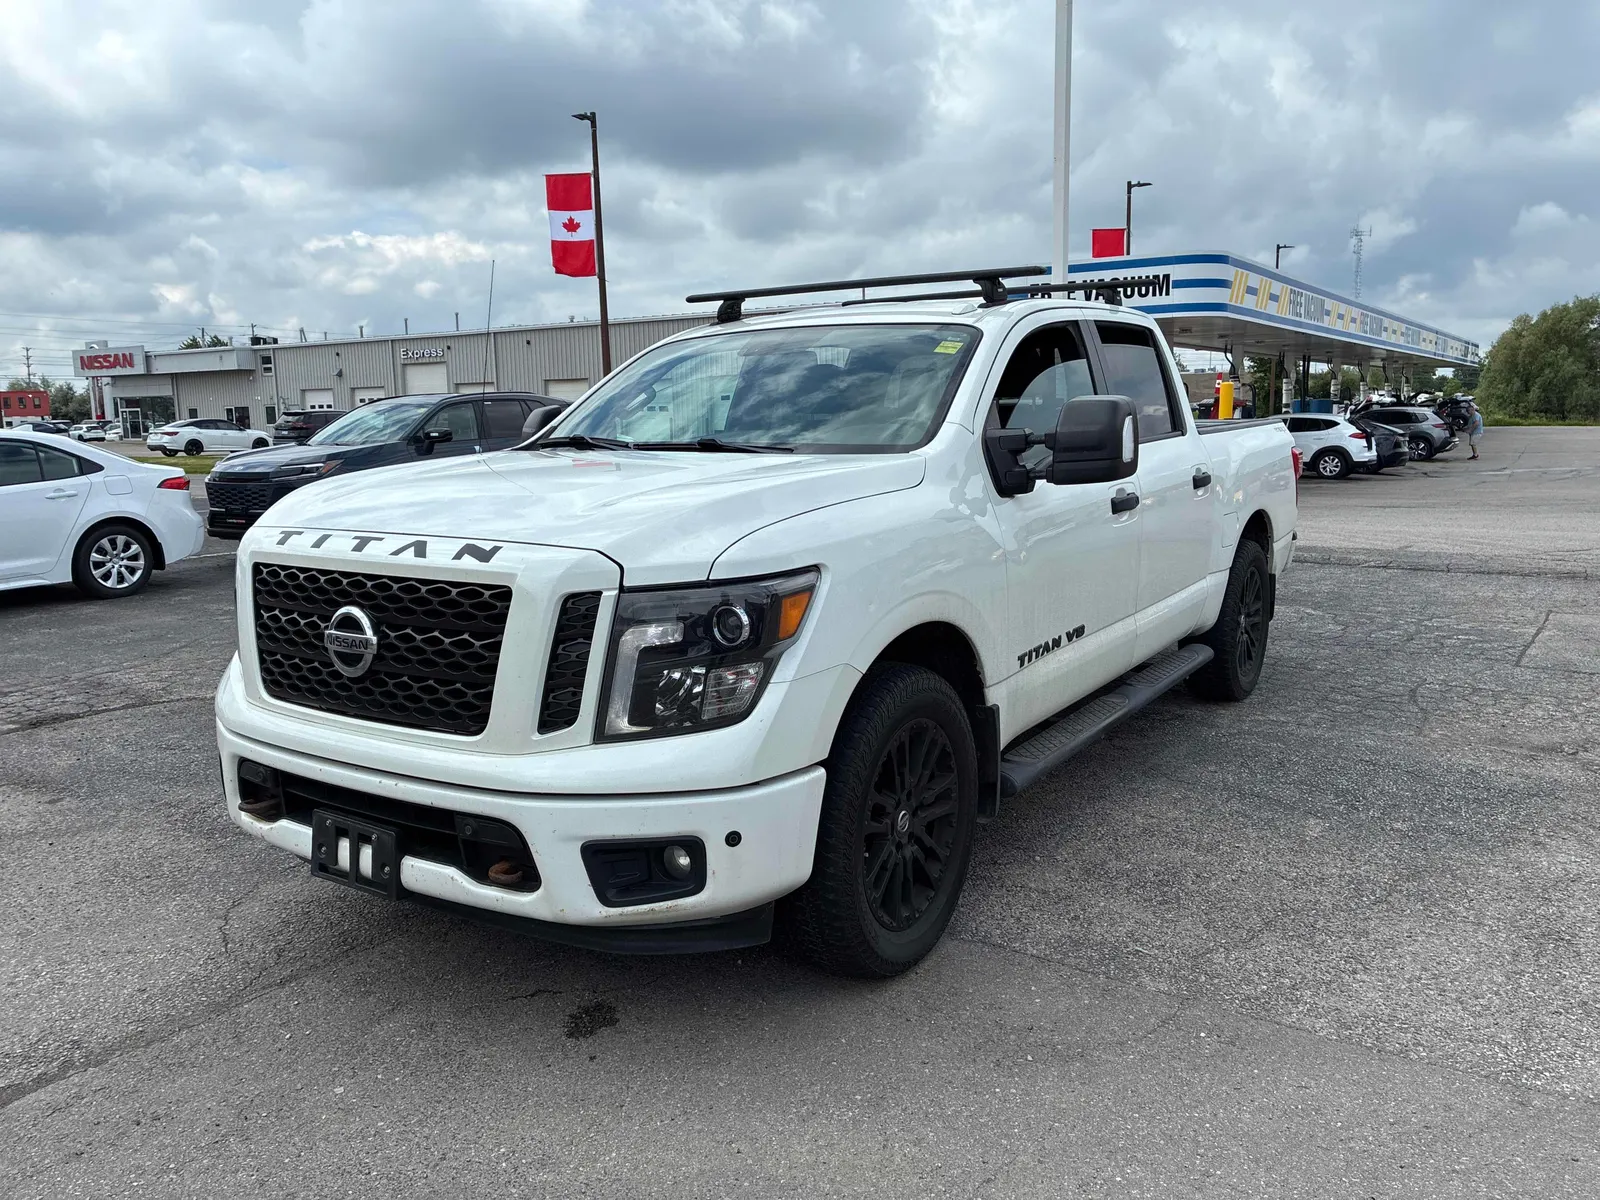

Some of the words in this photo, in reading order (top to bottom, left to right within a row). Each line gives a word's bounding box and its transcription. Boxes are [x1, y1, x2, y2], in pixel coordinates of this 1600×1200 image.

[1028, 280, 1076, 300] FRE
[1082, 274, 1171, 301] VAUUM
[1289, 288, 1304, 318] FREE
[80, 352, 135, 370] NISSAN
[400, 348, 444, 359] Express
[276, 530, 503, 563] TITAN
[326, 634, 369, 650] NISSAN
[1017, 634, 1062, 668] TITAN
